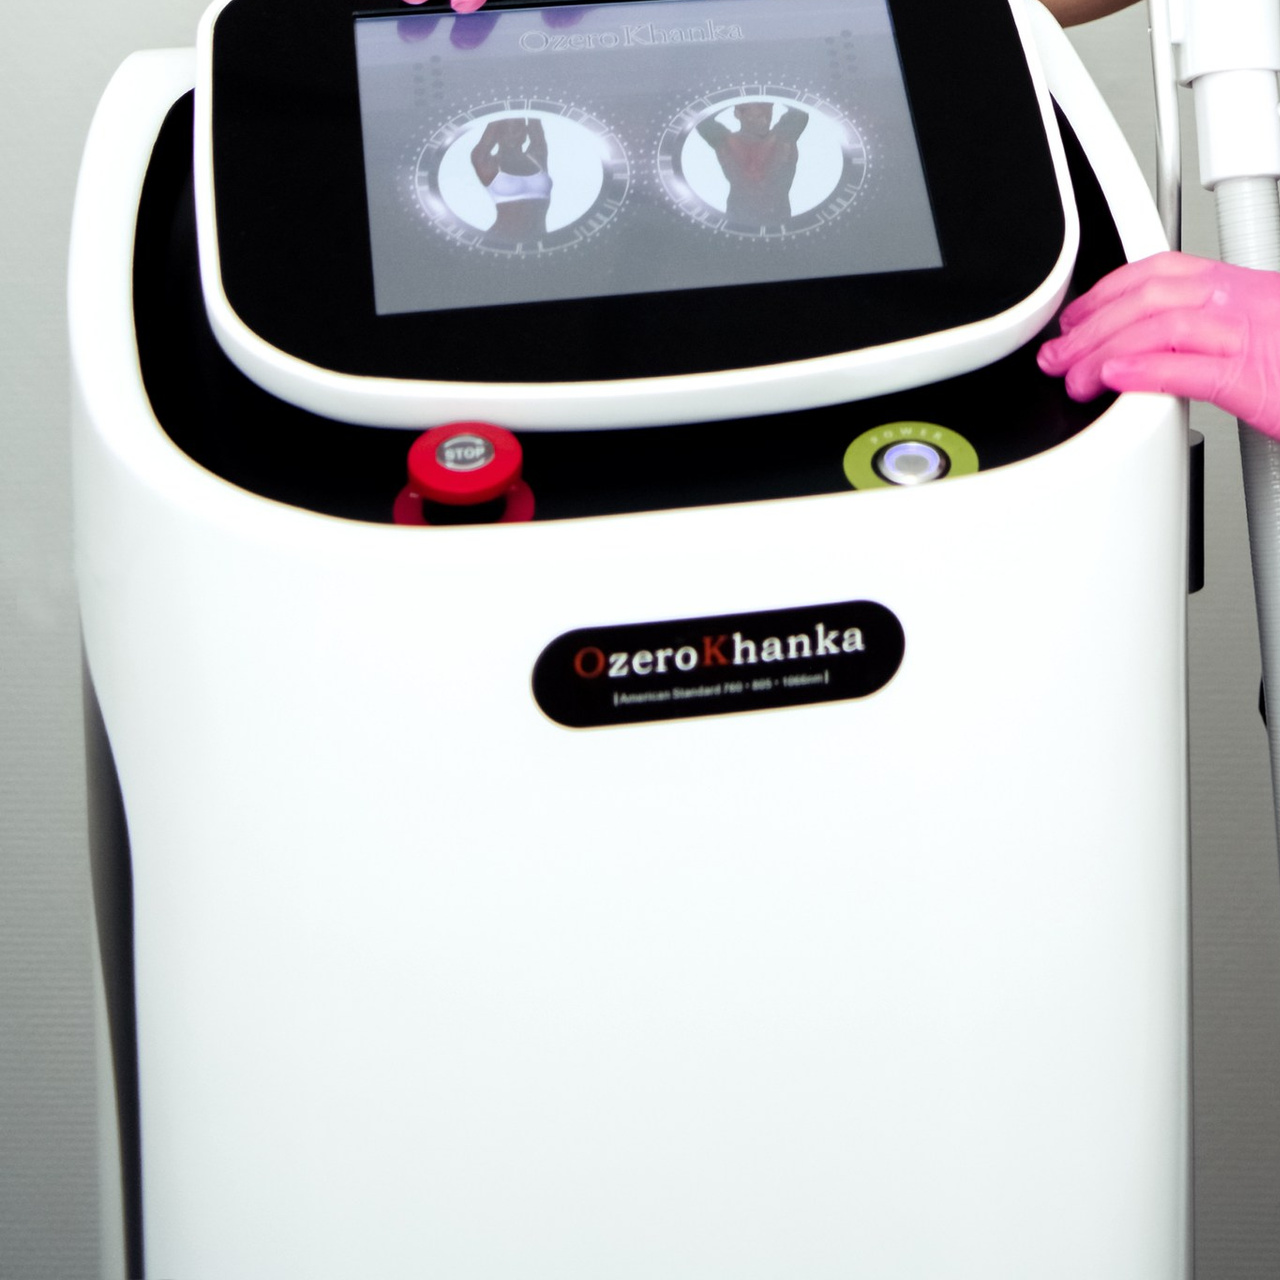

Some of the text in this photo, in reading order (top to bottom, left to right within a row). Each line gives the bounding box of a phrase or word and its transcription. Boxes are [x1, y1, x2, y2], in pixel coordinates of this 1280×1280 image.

[519, 19, 745, 53] OzeroKhanka
[870, 427, 942, 445] POWER
[444, 446, 485, 461] STOP
[574, 623, 866, 678] OzeroKhanka
